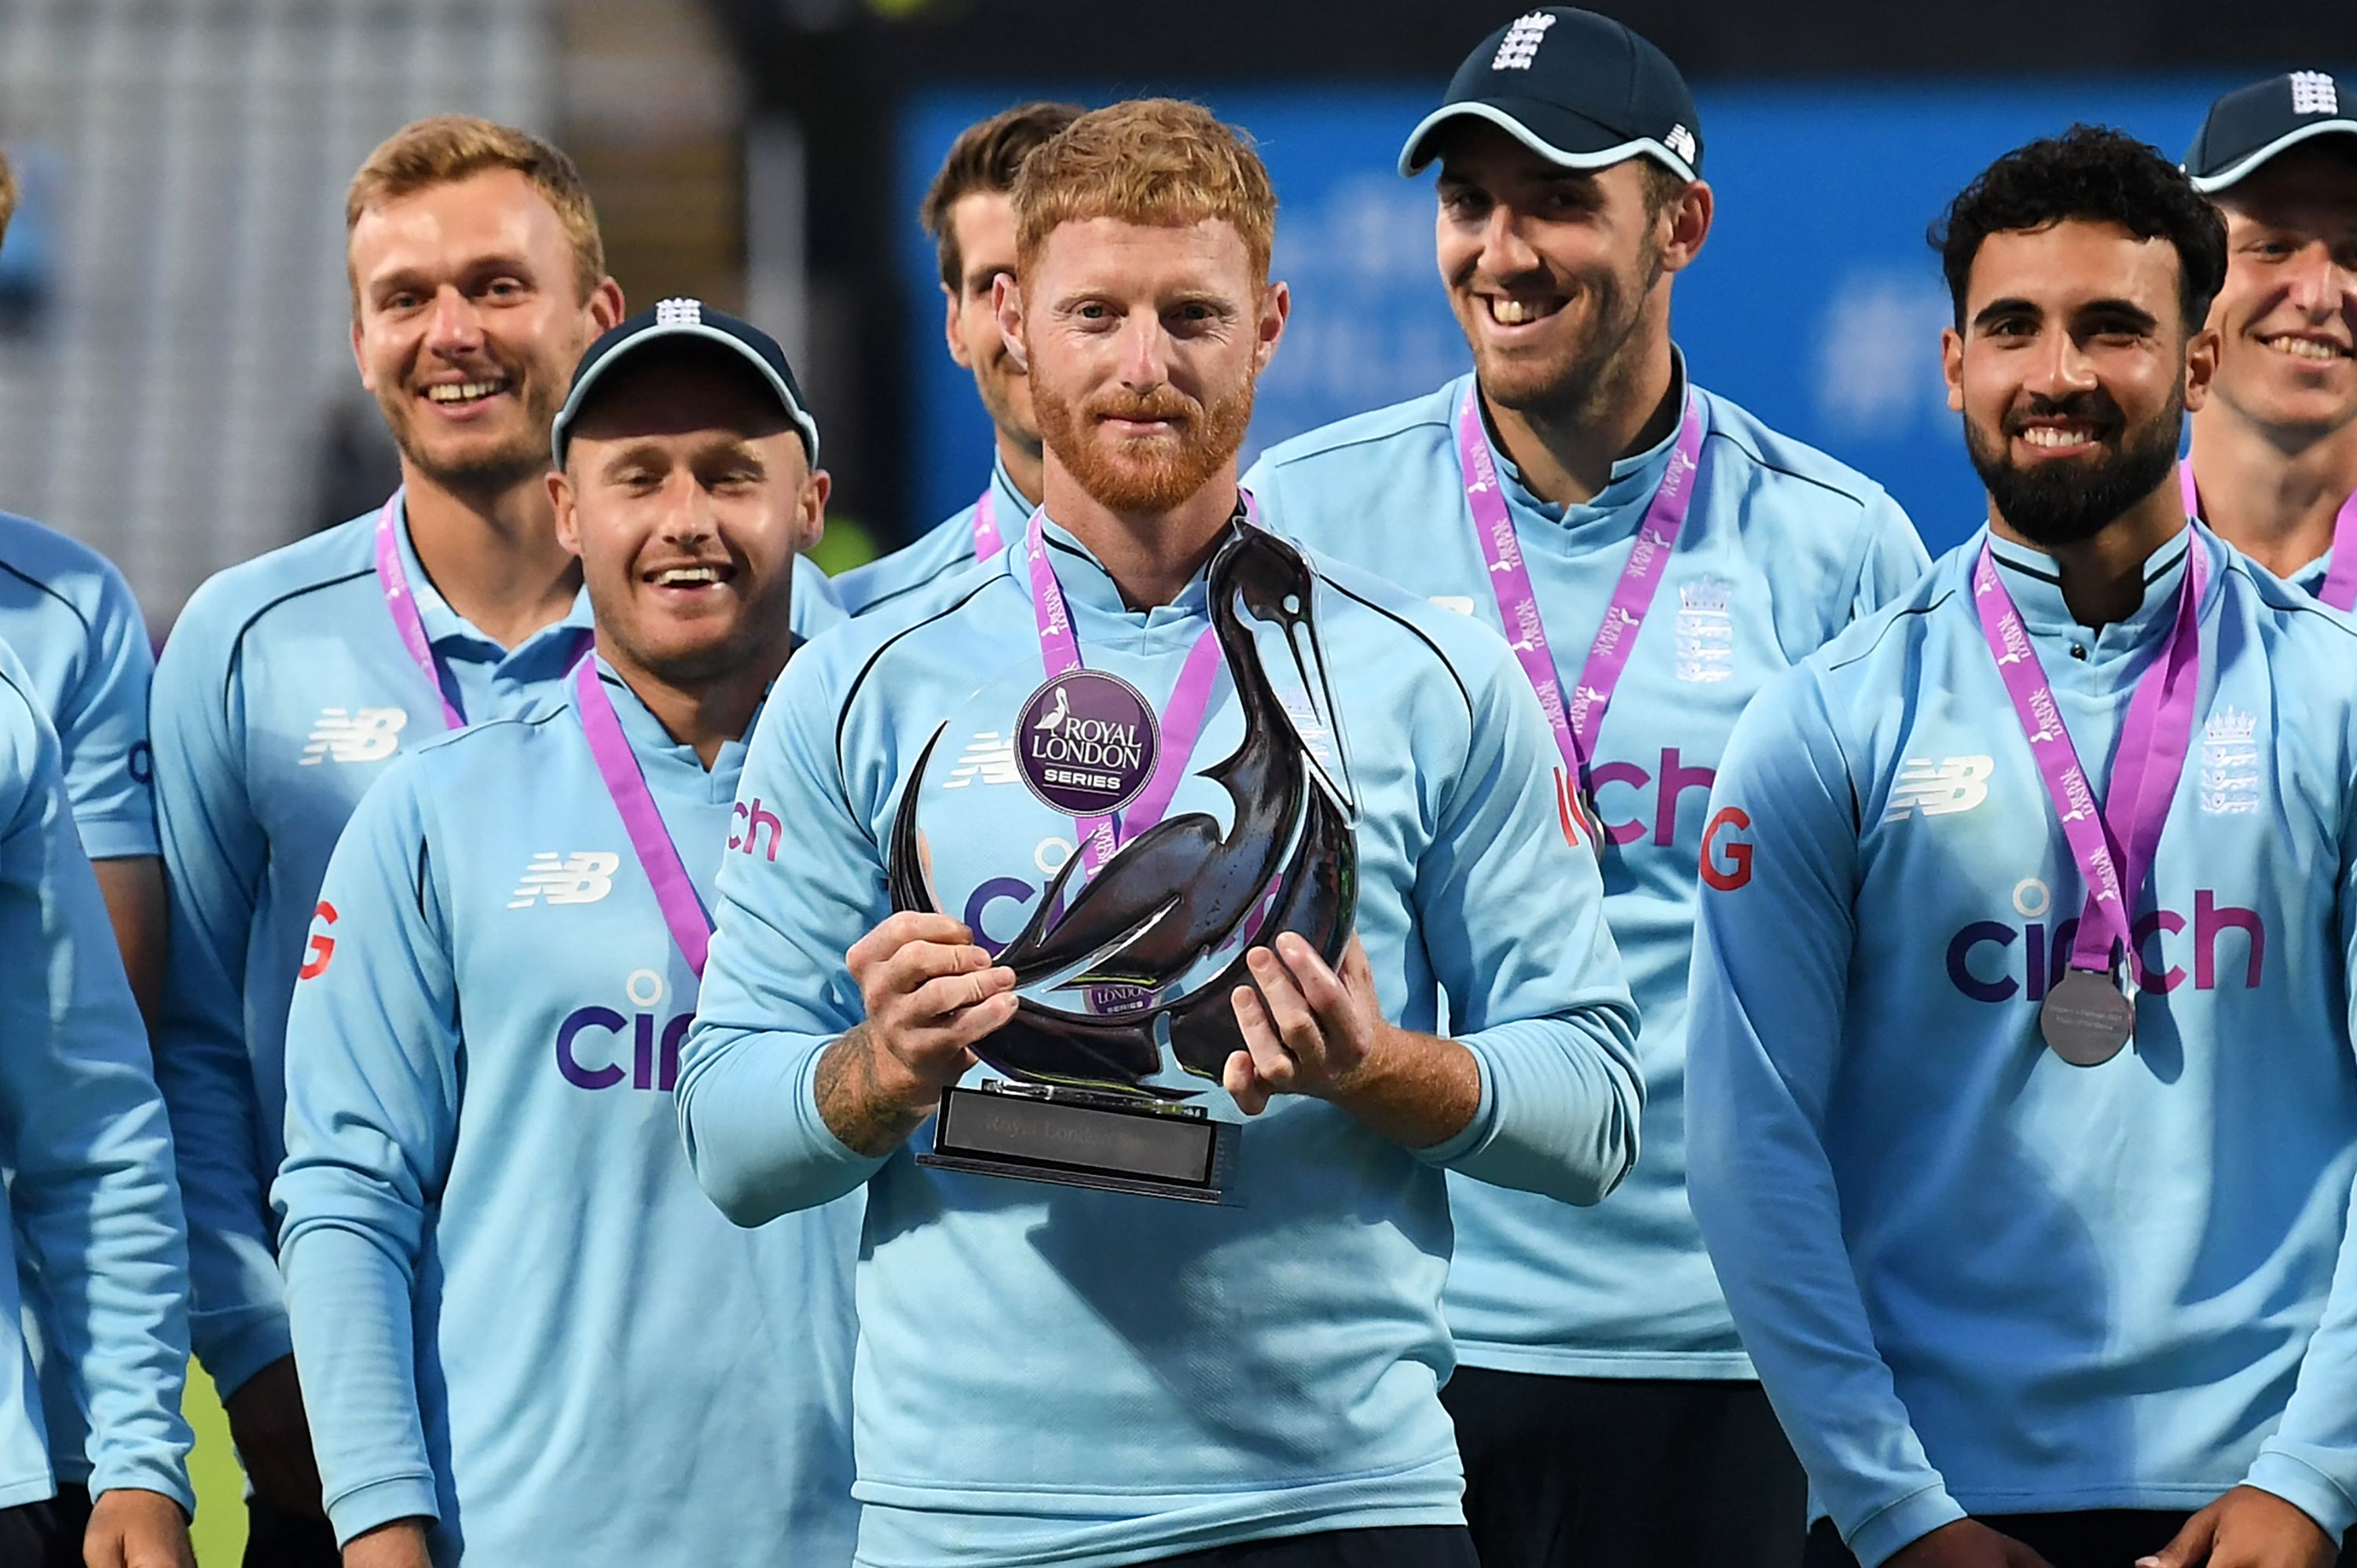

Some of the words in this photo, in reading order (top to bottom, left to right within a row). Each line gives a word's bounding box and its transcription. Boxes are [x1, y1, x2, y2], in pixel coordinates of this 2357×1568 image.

[1064, 717, 1142, 748] ROYAL
[1032, 735, 1142, 771] LONDON
[1043, 769, 1121, 789] SERIES
[1098, 988, 1146, 1004] LONDO
